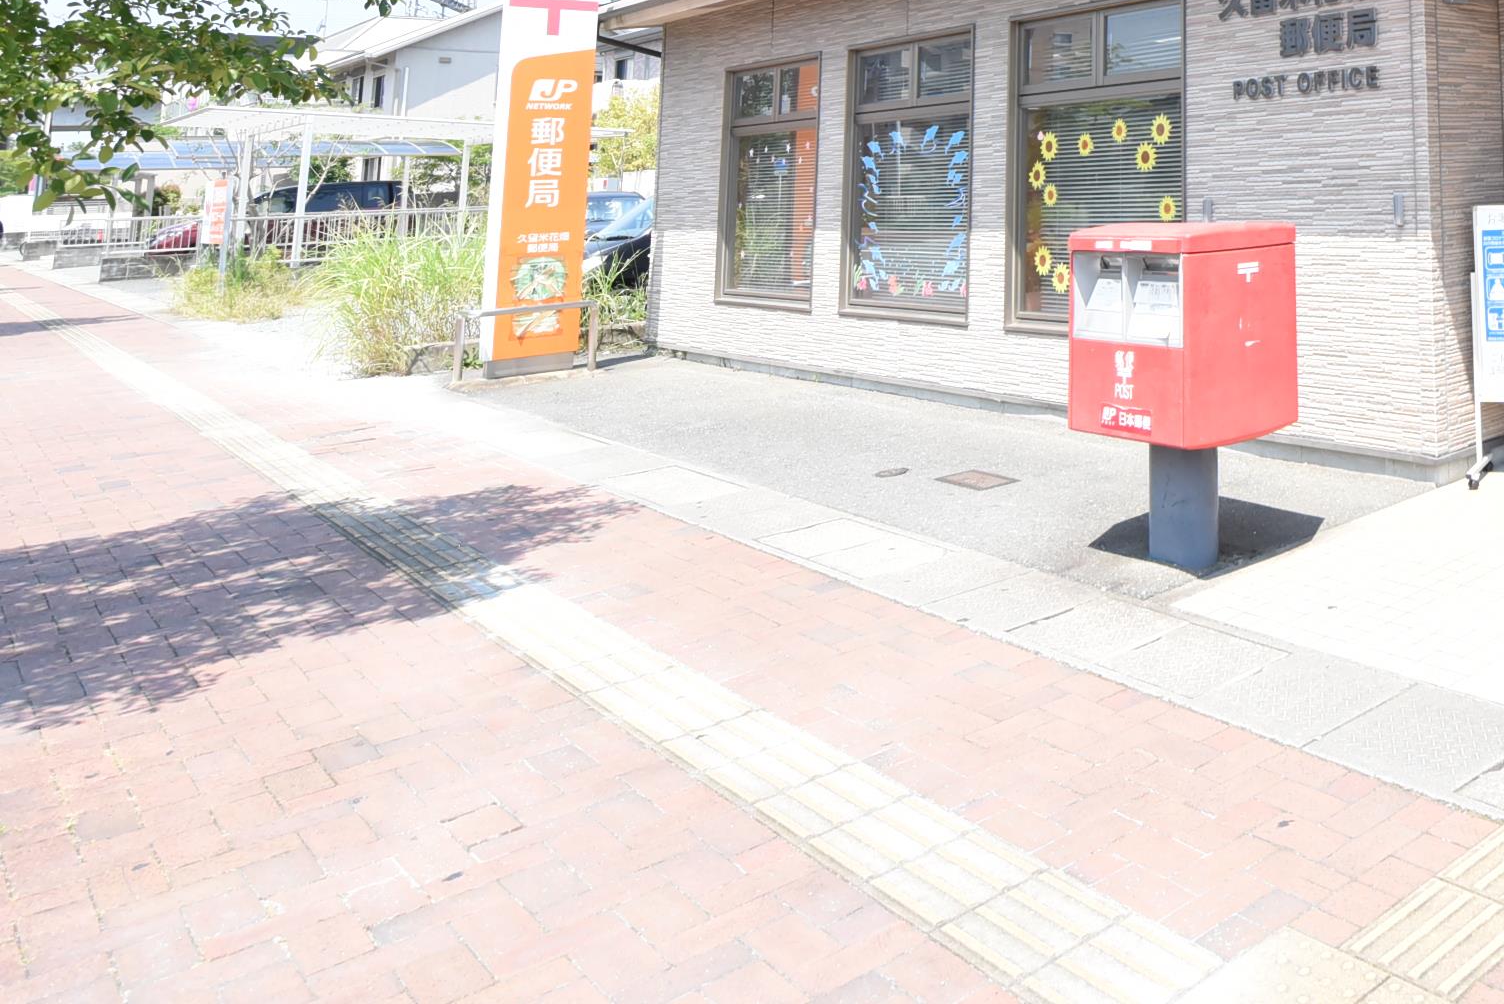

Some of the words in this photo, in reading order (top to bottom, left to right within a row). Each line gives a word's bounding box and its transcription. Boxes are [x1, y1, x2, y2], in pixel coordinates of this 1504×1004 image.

[1279, 7, 1378, 58] 郵便局
[1233, 74, 1288, 101] POST
[1297, 65, 1380, 94] OFFICE
[526, 103, 572, 111] NETWORK
[525, 117, 565, 208] 郵便局
[1114, 383, 1135, 400] POST
[1118, 412, 1152, 430] 日本郵便
